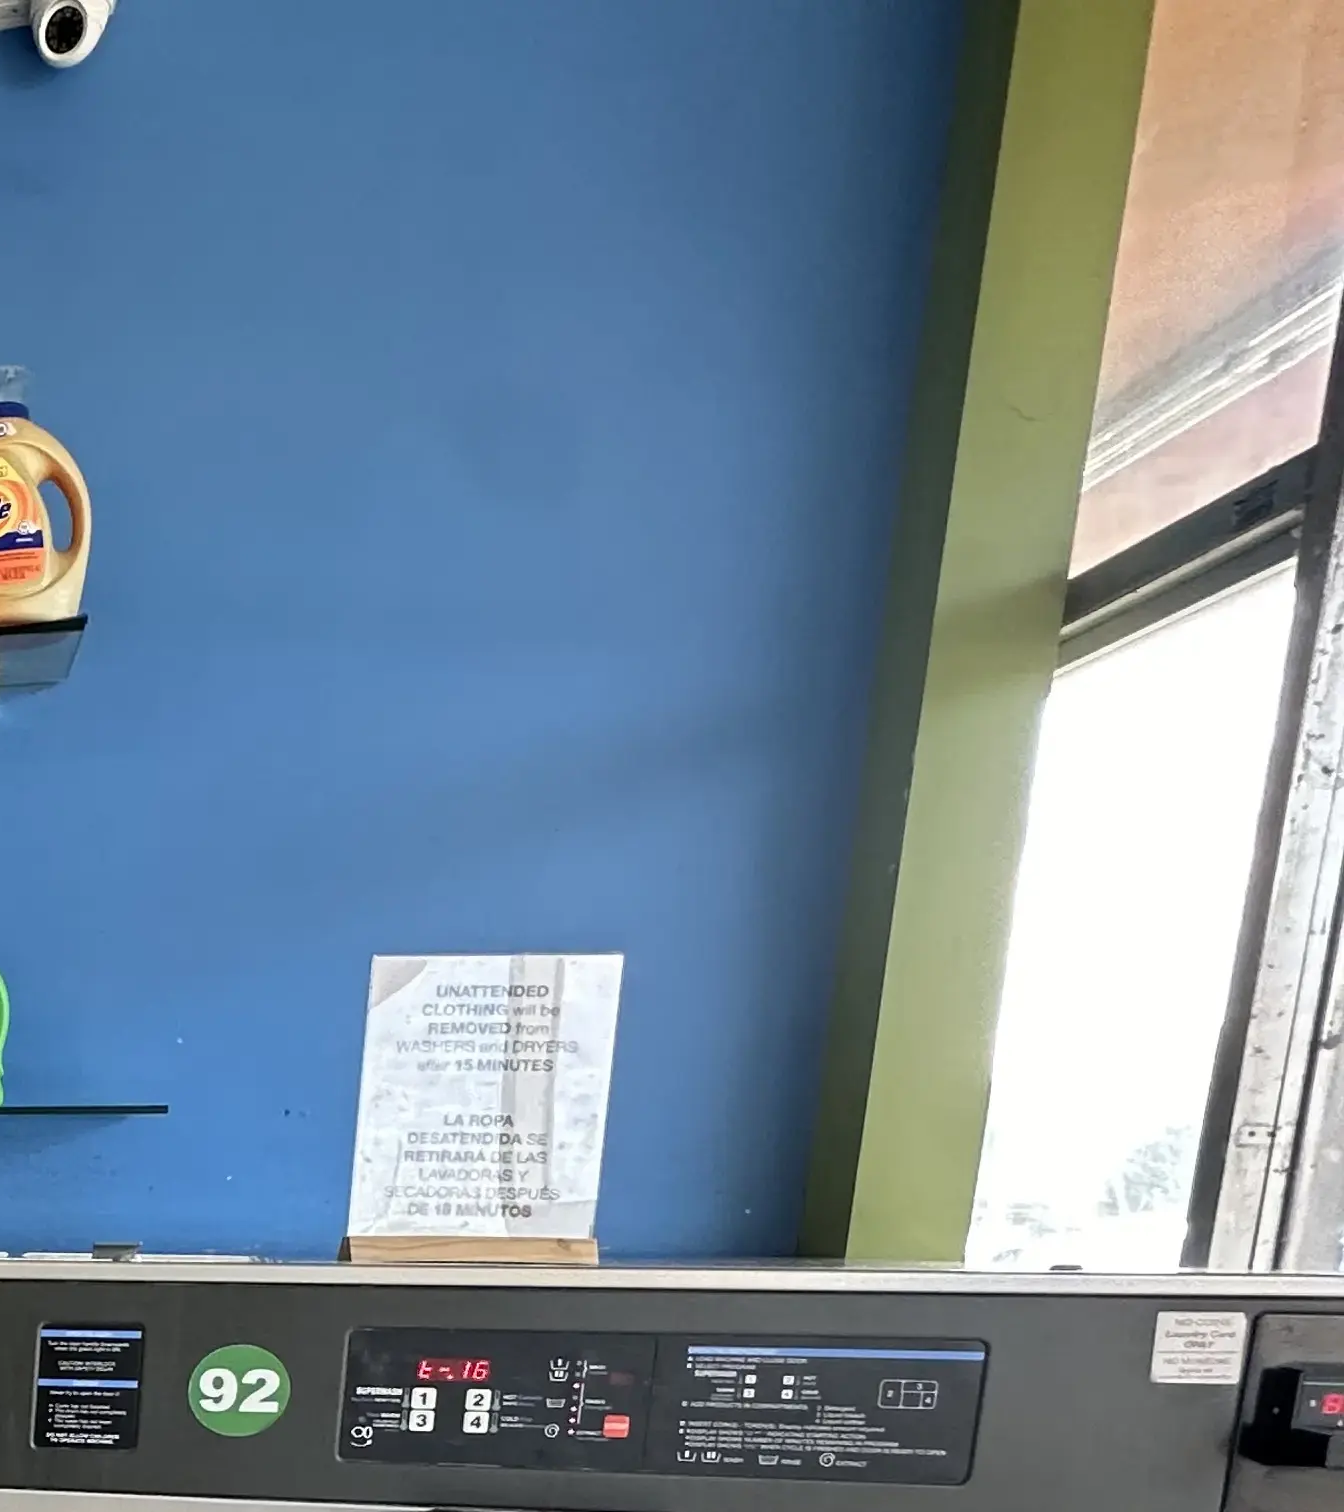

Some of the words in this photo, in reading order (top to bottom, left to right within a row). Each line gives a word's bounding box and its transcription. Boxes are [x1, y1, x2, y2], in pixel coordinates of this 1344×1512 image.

[436, 985, 549, 997] UNATTENDED
[422, 1004, 508, 1016] CLOTHING
[513, 1005, 536, 1016] will
[540, 1004, 560, 1016] be
[427, 1022, 511, 1034] REMOVED
[515, 1022, 549, 1035] from
[396, 1040, 475, 1053] WASHERS
[479, 1041, 508, 1053] and
[513, 1040, 579, 1054] DRYERS
[455, 1059, 474, 1071] 15
[477, 1059, 554, 1072] MINUTES
[444, 1114, 464, 1126] LA
[468, 1114, 514, 1127] ROPA
[407, 1132, 522, 1145] DESATENDIDA
[526, 1133, 548, 1146] SE
[404, 1148, 485, 1163] RETIRARÁ
[490, 1151, 511, 1163] DE
[517, 1151, 548, 1164] LAS
[418, 1168, 512, 1182] LAVADORAS
[518, 1170, 530, 1182] Y
[384, 1186, 481, 1199] SECADORAS
[486, 1186, 560, 1200] DESPUÉS
[408, 1203, 429, 1216] DE
[456, 1204, 532, 1218] MINUTOS
[198, 1368, 281, 1414] 92
[473, 1394, 484, 1407] 2
[416, 1414, 427, 1428] 3
[469, 1415, 482, 1429] 4
